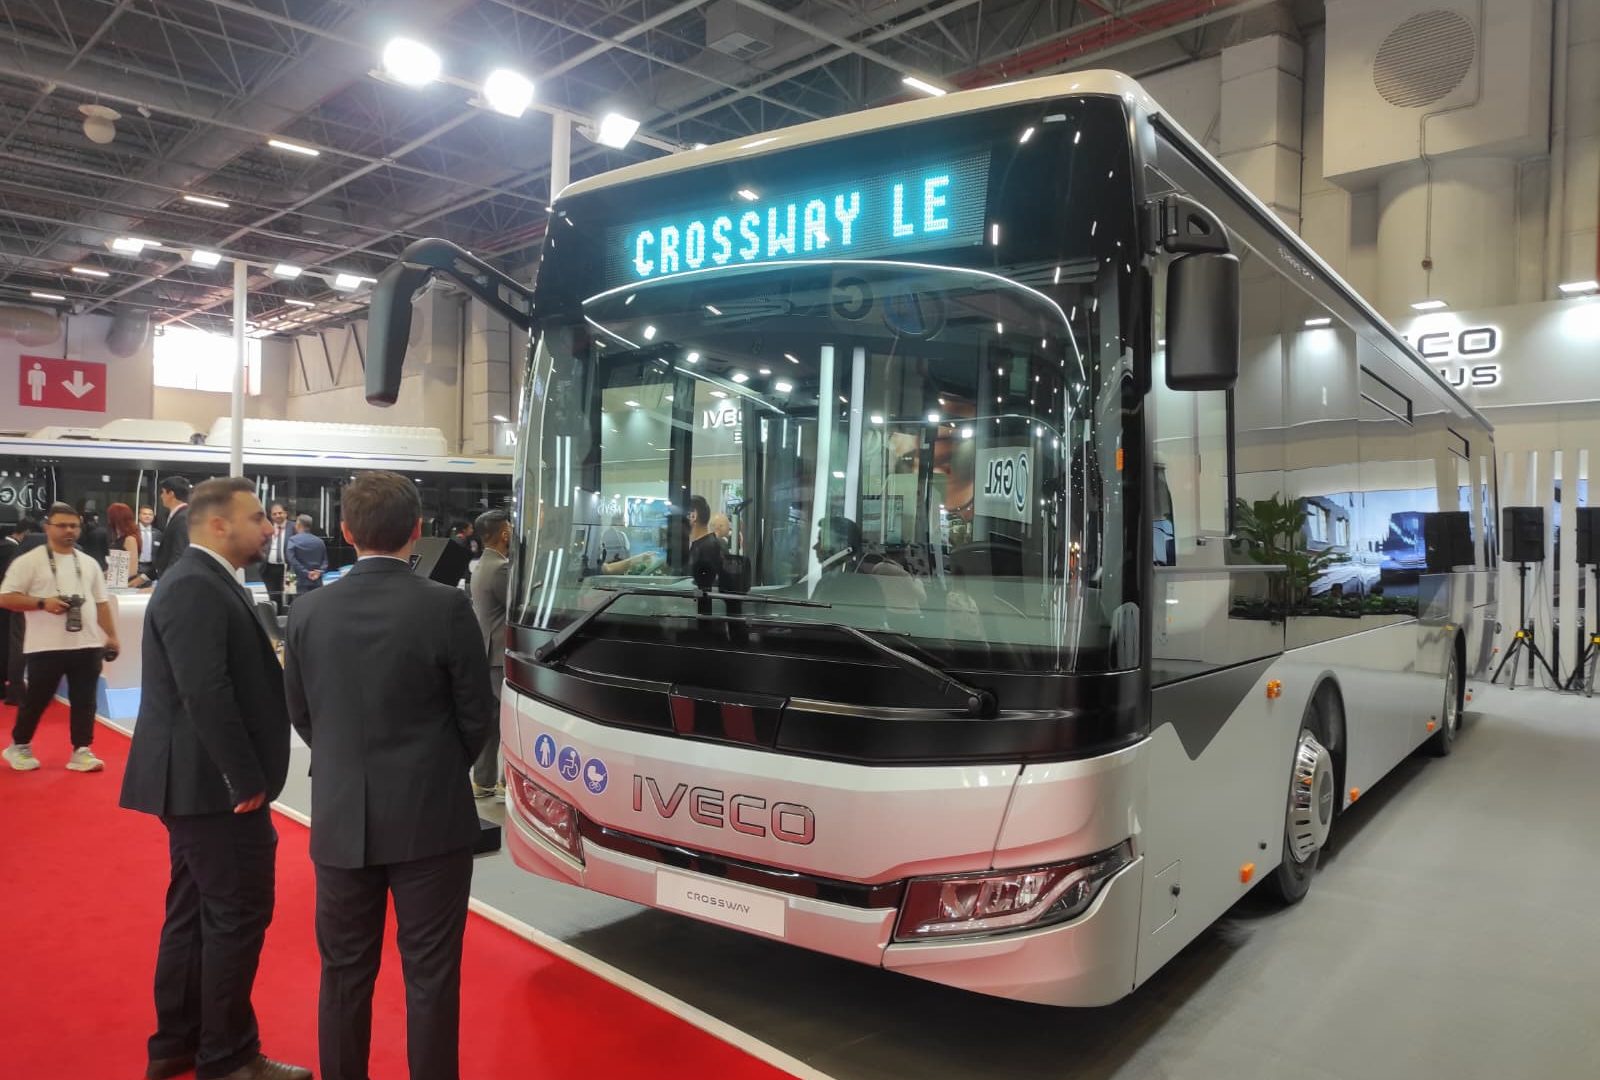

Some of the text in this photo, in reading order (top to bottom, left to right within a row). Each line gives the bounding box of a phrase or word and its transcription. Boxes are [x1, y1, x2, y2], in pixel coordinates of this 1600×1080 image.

[633, 175, 950, 276] CROSSWAY LE
[1403, 327, 1497, 358] CO
[632, 774, 815, 846] IVECO
[686, 890, 751, 915] CROSSWAY
